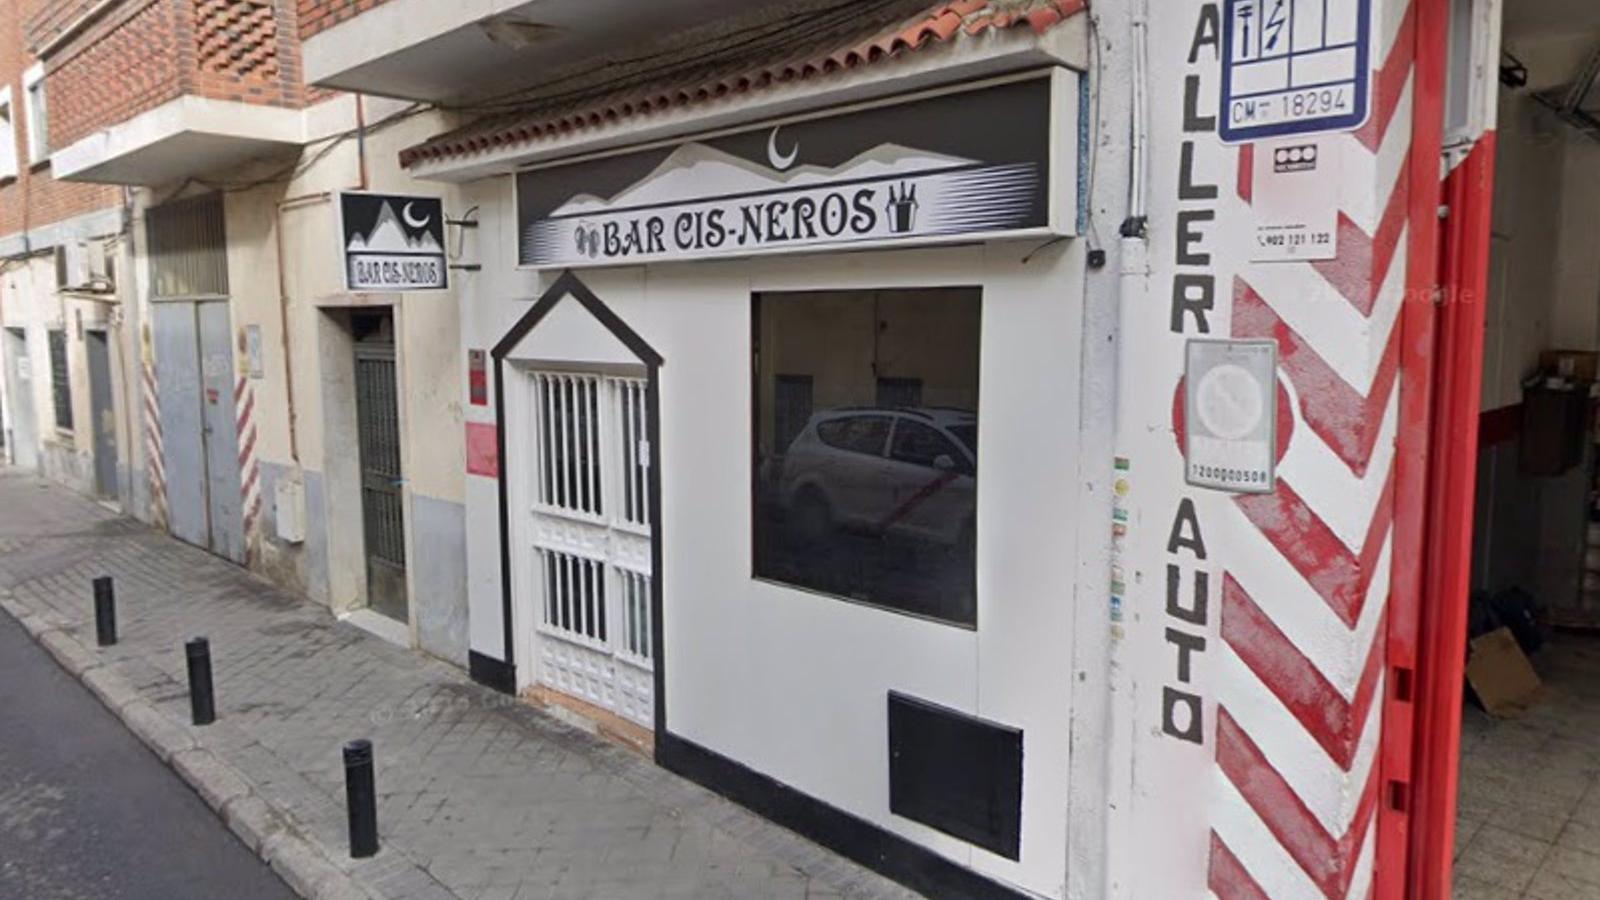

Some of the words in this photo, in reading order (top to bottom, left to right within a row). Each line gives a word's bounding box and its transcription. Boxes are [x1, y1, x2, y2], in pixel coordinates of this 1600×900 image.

[1282, 88, 1345, 117] 18294
[603, 214, 667, 256] BAR
[674, 189, 877, 249] CIS-NEROS
[357, 261, 381, 283] BAR
[1163, 497, 1208, 745] AUTO
